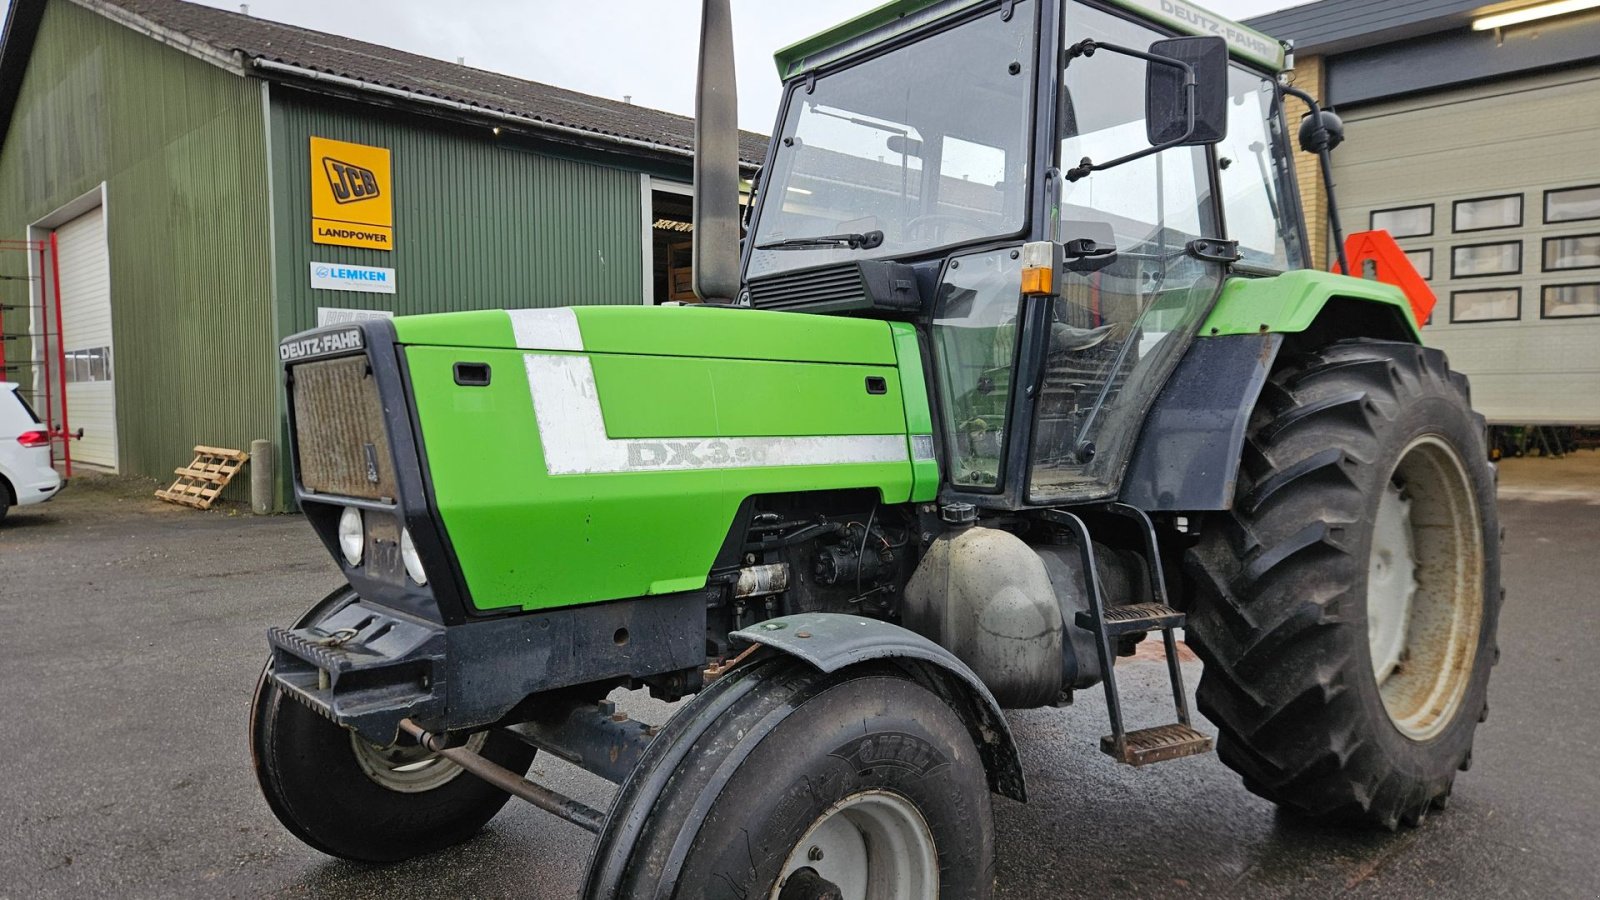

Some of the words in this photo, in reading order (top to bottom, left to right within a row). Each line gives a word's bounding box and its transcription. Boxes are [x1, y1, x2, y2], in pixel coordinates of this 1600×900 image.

[332, 163, 378, 200] JCB
[318, 227, 388, 243] LANDPOWER
[331, 267, 386, 282] LEMKEN
